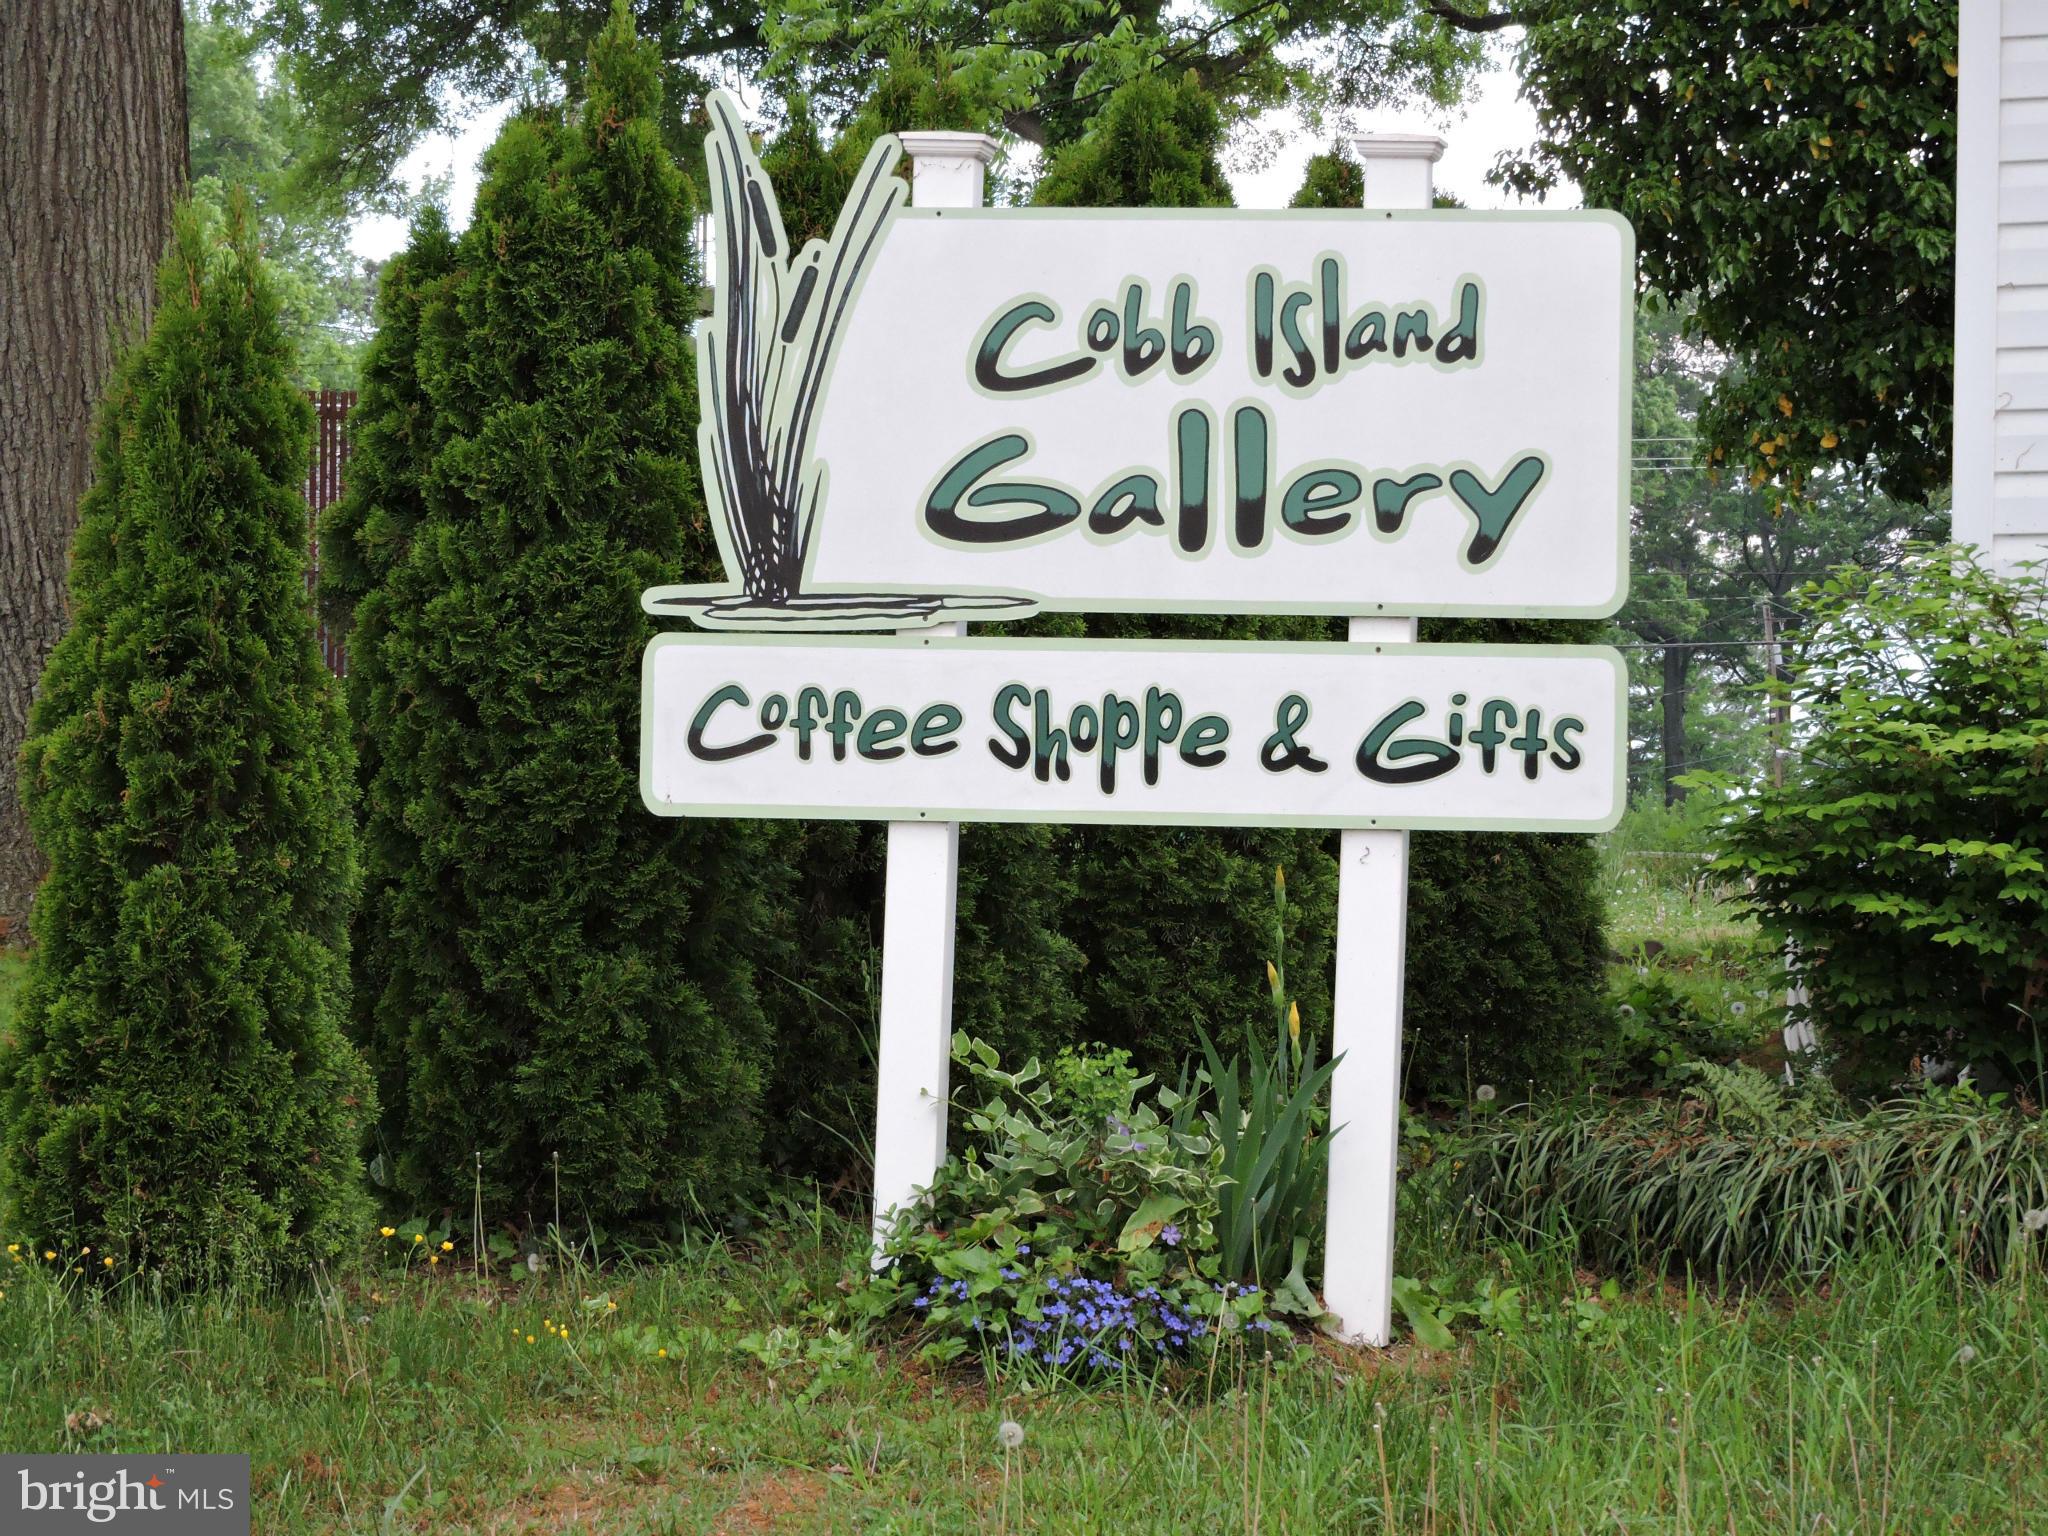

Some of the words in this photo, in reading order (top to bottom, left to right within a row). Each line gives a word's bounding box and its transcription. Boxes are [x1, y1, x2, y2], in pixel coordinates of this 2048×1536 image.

[974, 281, 1215, 393] Cobb
[1254, 257, 1480, 388] Island
[924, 405, 1545, 565] Gallery
[686, 684, 963, 762] Coffee
[988, 683, 1230, 795] Shoppe
[1260, 694, 1329, 774] &
[1355, 693, 1585, 785] Gifts
